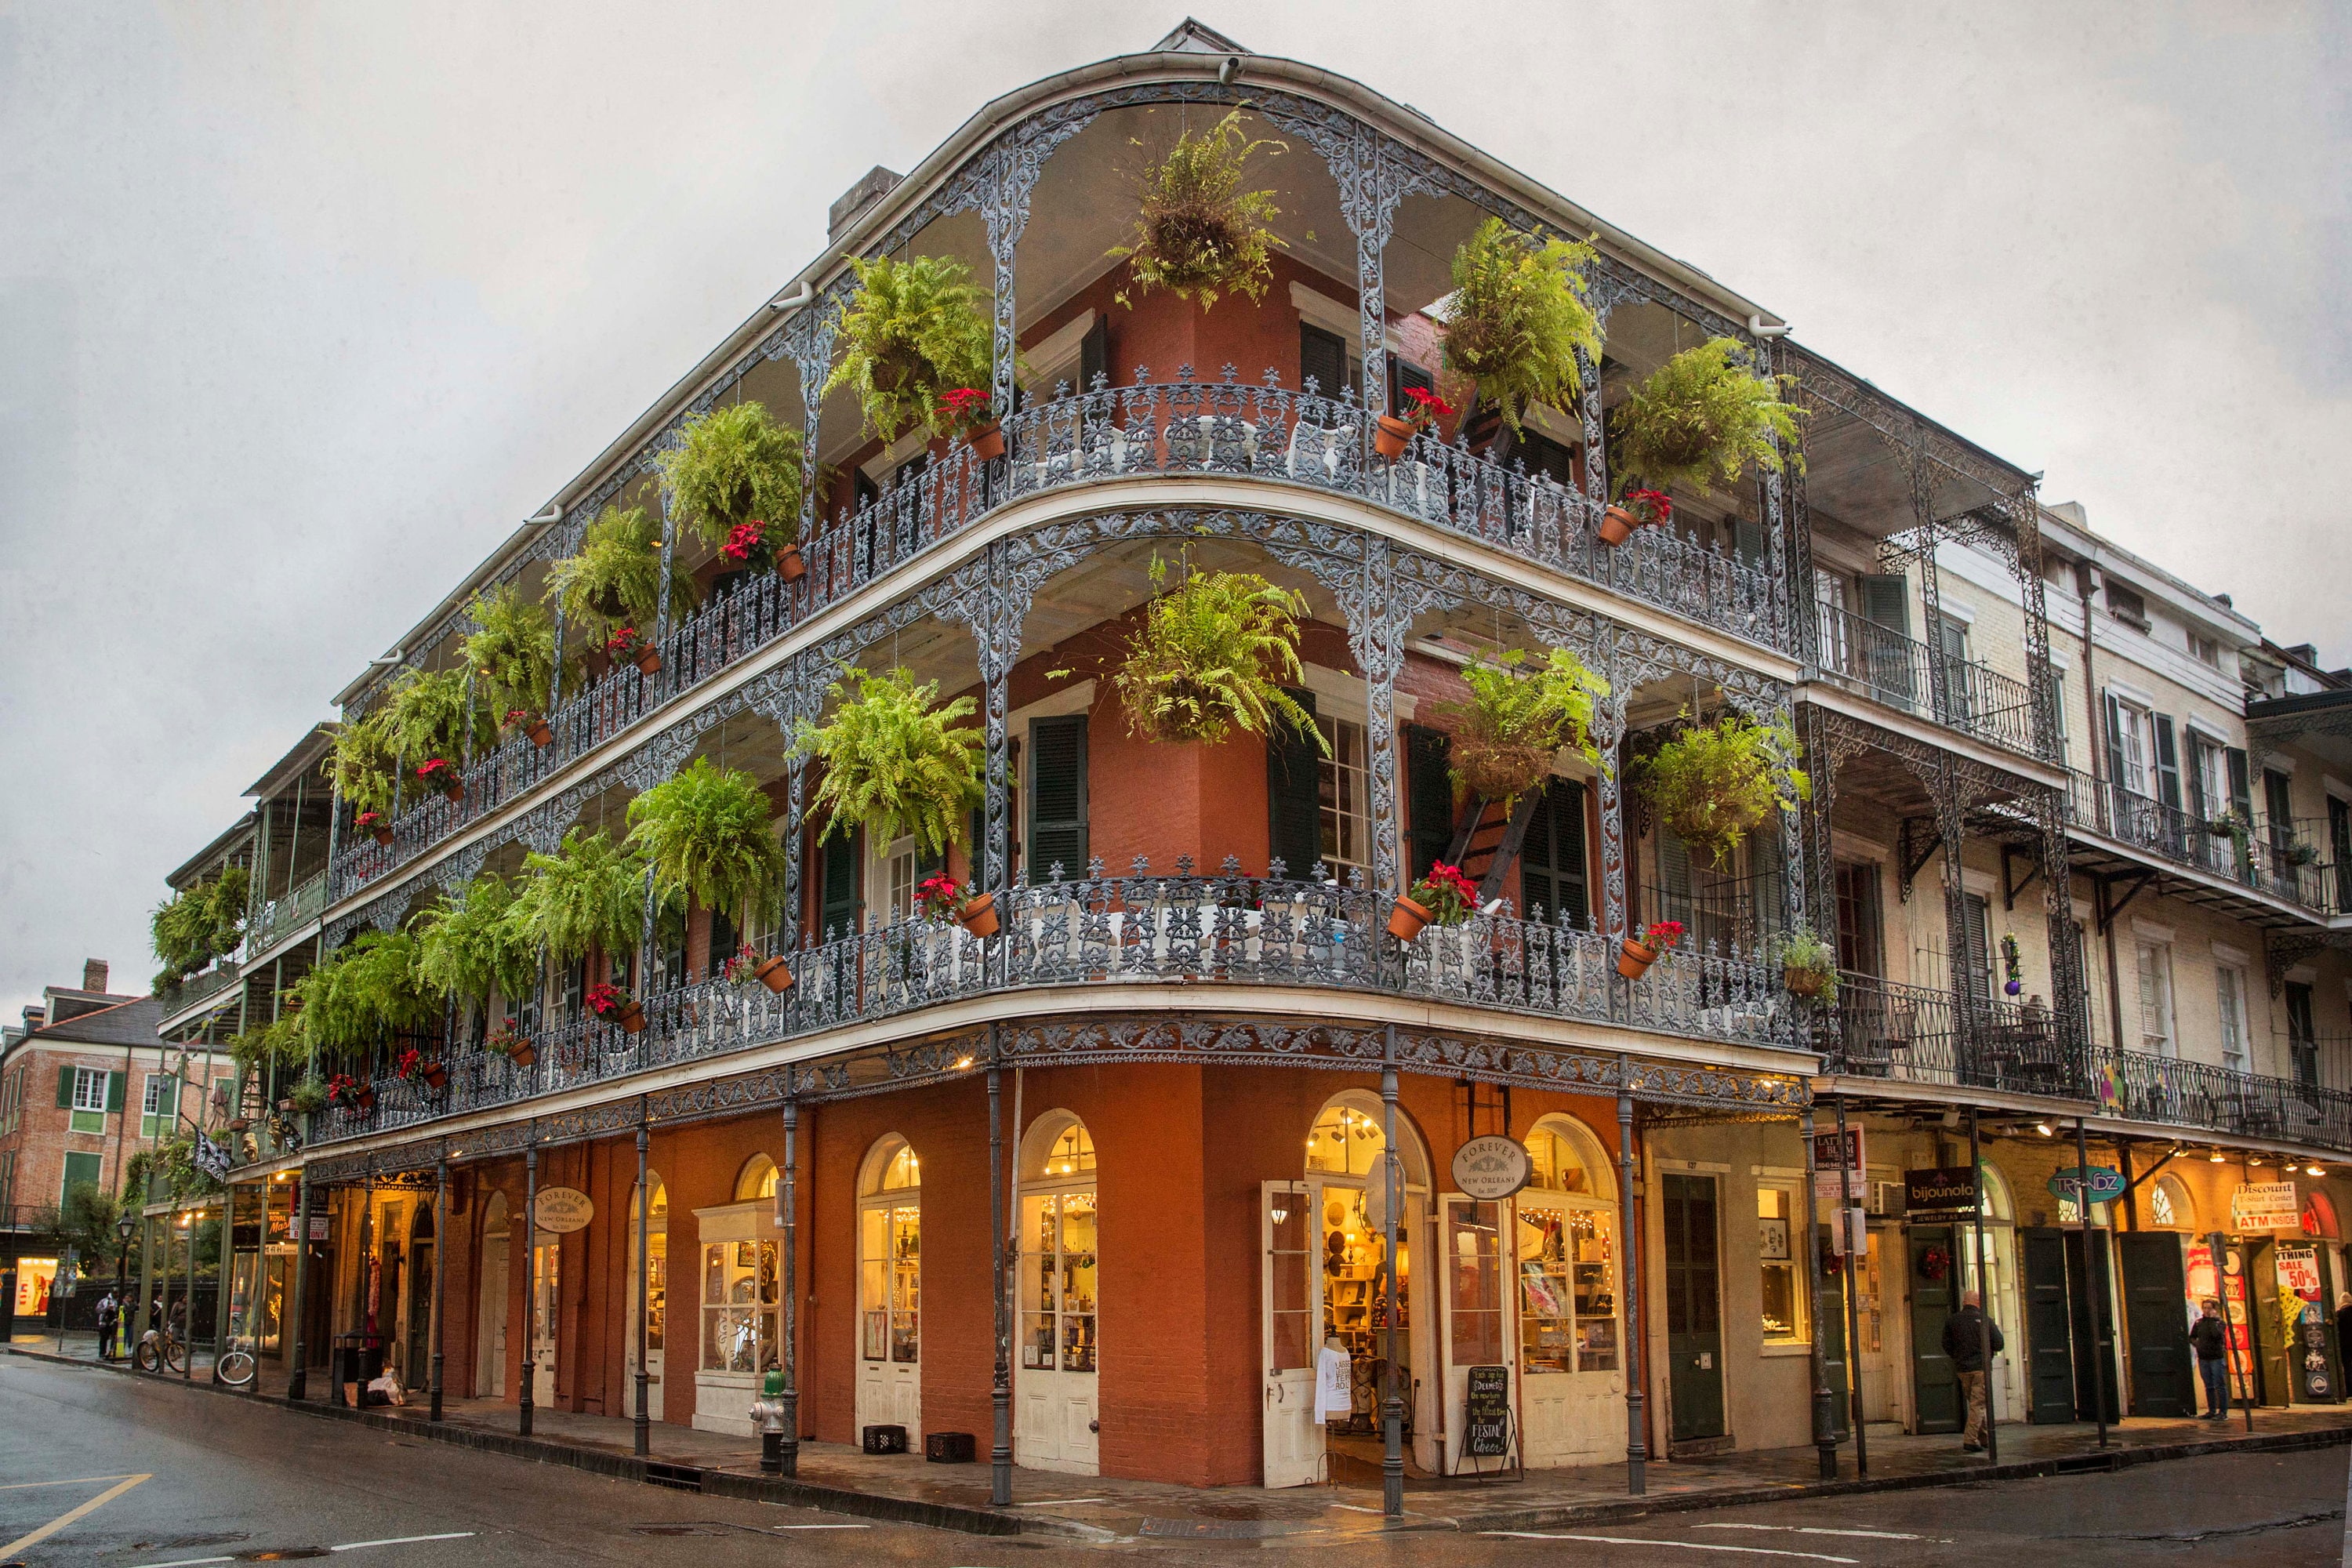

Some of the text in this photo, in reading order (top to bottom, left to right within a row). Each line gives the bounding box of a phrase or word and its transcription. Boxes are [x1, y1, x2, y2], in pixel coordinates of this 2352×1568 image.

[1817, 1136, 1853, 1145] LATTR
[1462, 1142, 1515, 1162] FOREVER
[1828, 1145, 1854, 1154] BLM
[1912, 1183, 1974, 1202] bijounola
[2238, 1184, 2292, 1194] Discount
[539, 1191, 586, 1207] FOREVER
[2241, 1216, 2296, 1227] ATM INSIDE
[294, 1230, 325, 1239] BONY
[2275, 1250, 2313, 1261] YTHING
[2278, 1261, 2303, 1270] SALE
[2288, 1269, 2318, 1287] 50%
